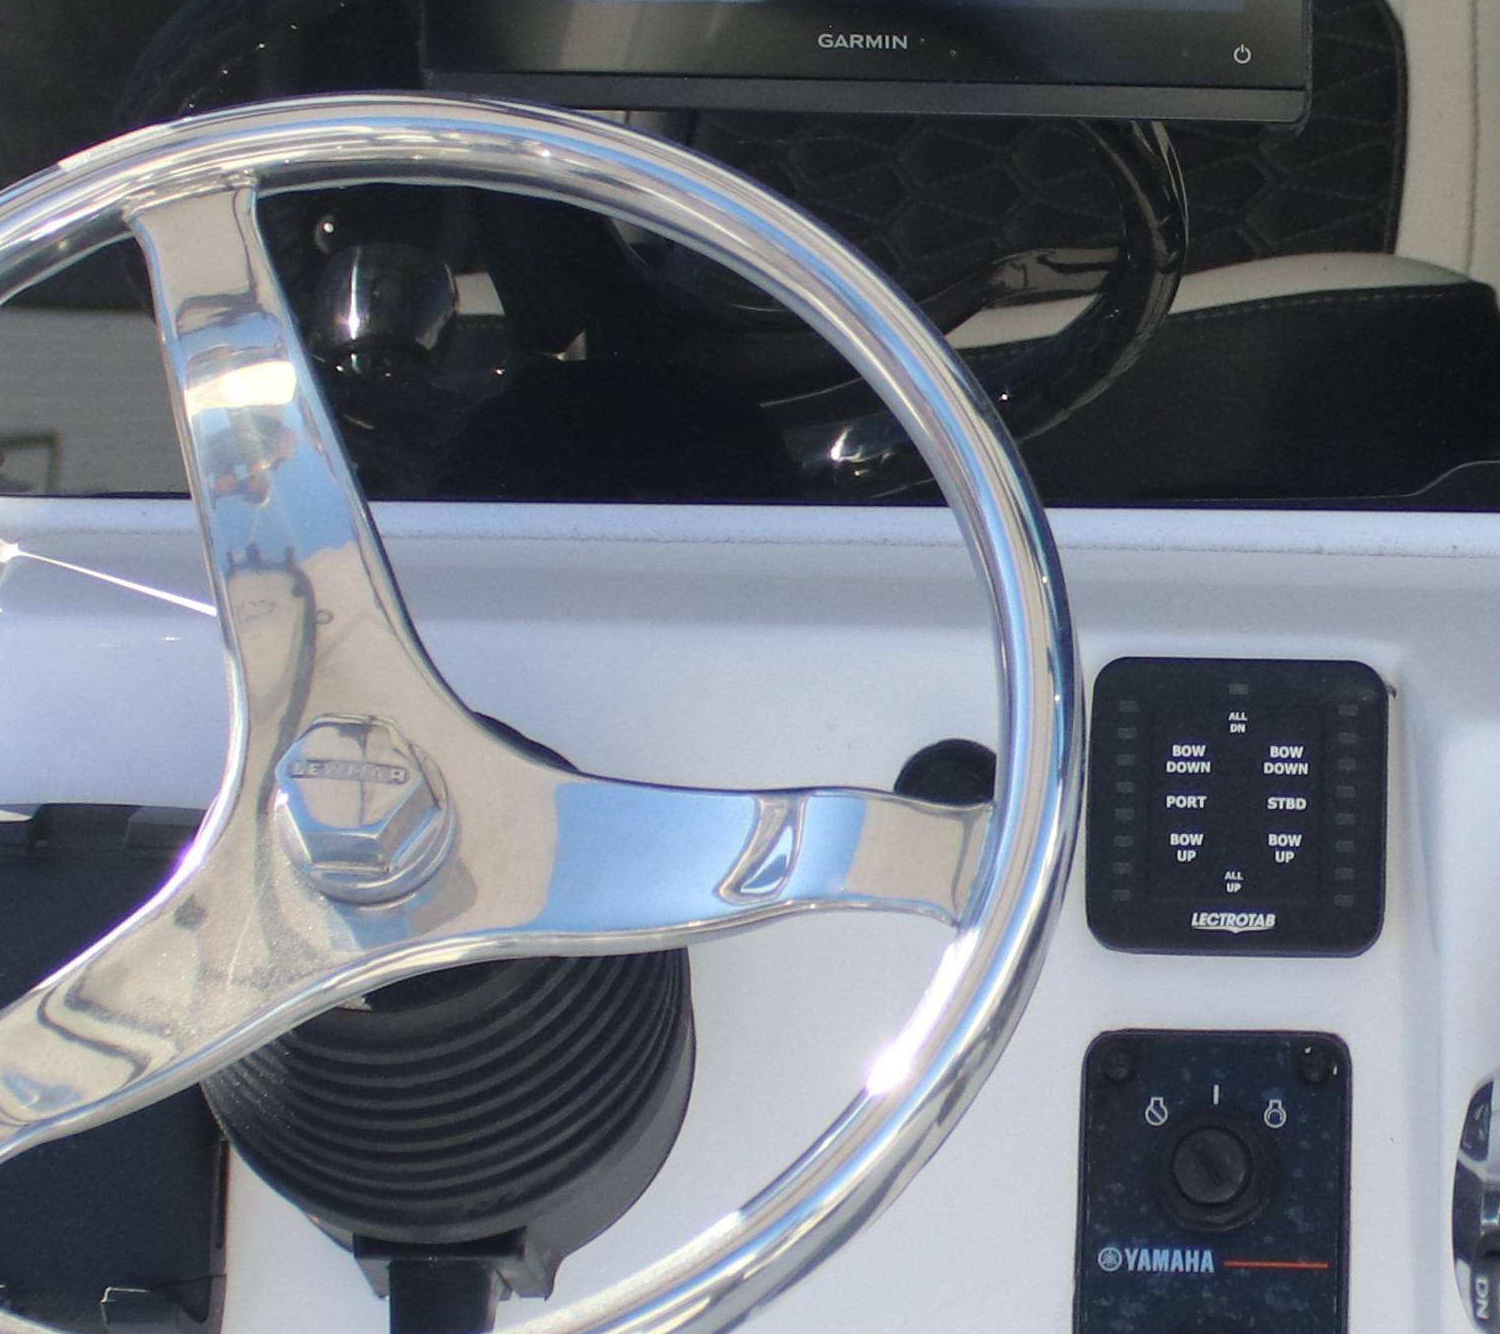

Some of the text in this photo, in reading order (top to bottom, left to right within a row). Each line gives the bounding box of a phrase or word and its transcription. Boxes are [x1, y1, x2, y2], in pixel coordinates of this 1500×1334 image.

[817, 33, 908, 49] GARMIN
[1228, 711, 1248, 721] ALL
[1229, 723, 1246, 733] DN
[1172, 744, 1206, 757] BOW
[1269, 746, 1304, 759] BOW
[292, 762, 407, 782] LEWMAR
[1166, 761, 1211, 774] DOWN
[1263, 762, 1308, 775] DOWN
[1166, 795, 1207, 808] PORT
[1267, 797, 1307, 810] STBD
[1170, 833, 1204, 846] BOW
[1268, 834, 1302, 847] BOW
[1177, 850, 1196, 862] UP
[1275, 851, 1295, 863] UP
[1224, 871, 1244, 881] ALL
[1226, 883, 1242, 893] UP
[1191, 912, 1276, 928] LECTROTAB
[1124, 1247, 1214, 1273] YAMAHA
[1476, 1278, 1489, 1320] DN
